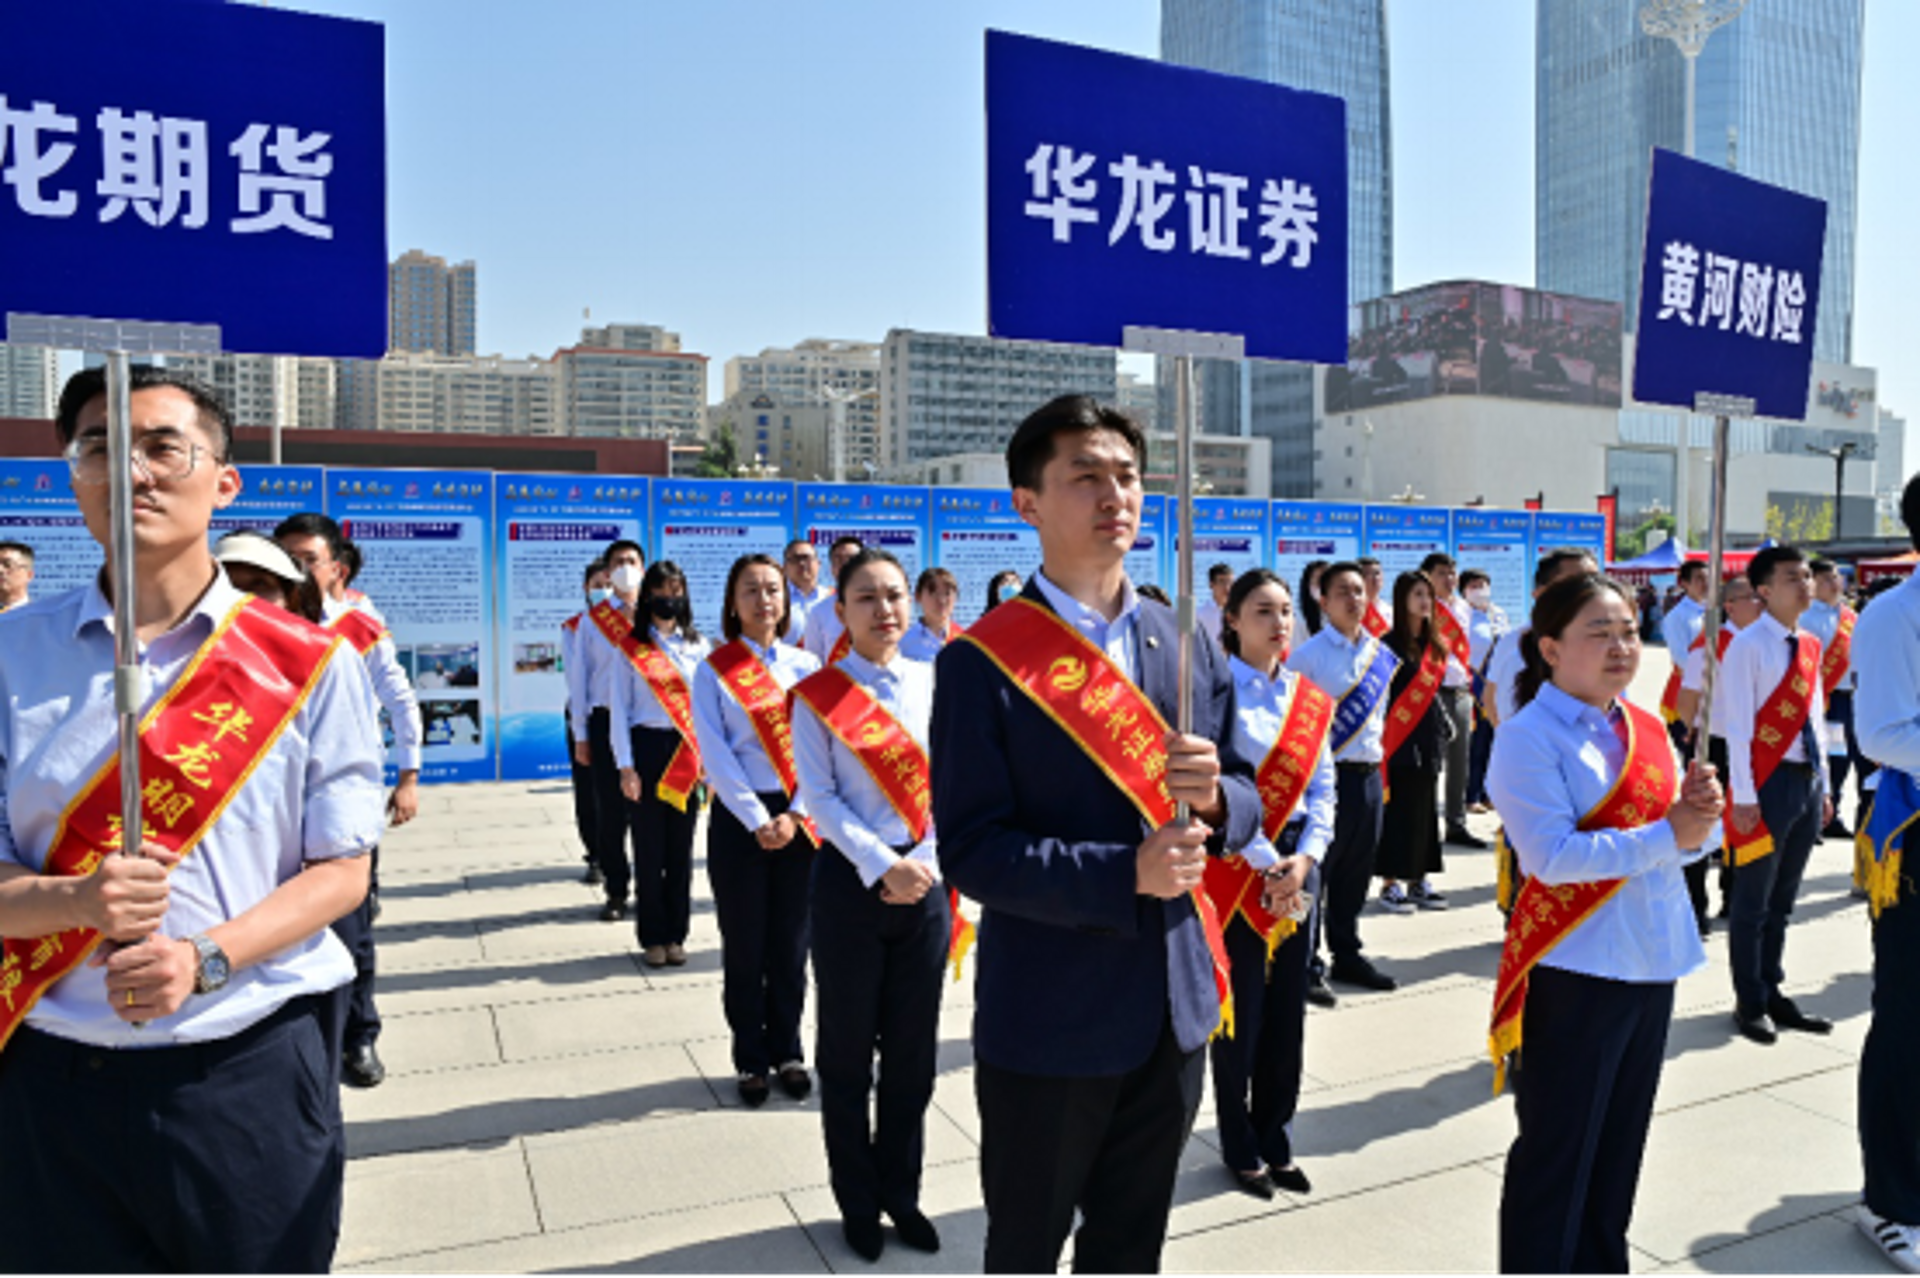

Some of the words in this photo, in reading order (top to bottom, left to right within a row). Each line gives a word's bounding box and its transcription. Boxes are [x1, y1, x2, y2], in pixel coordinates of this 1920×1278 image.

[0, 94, 334, 240] 龙期货
[1024, 142, 1320, 269] 华龙证券
[1656, 240, 1806, 343] 黄河财险
